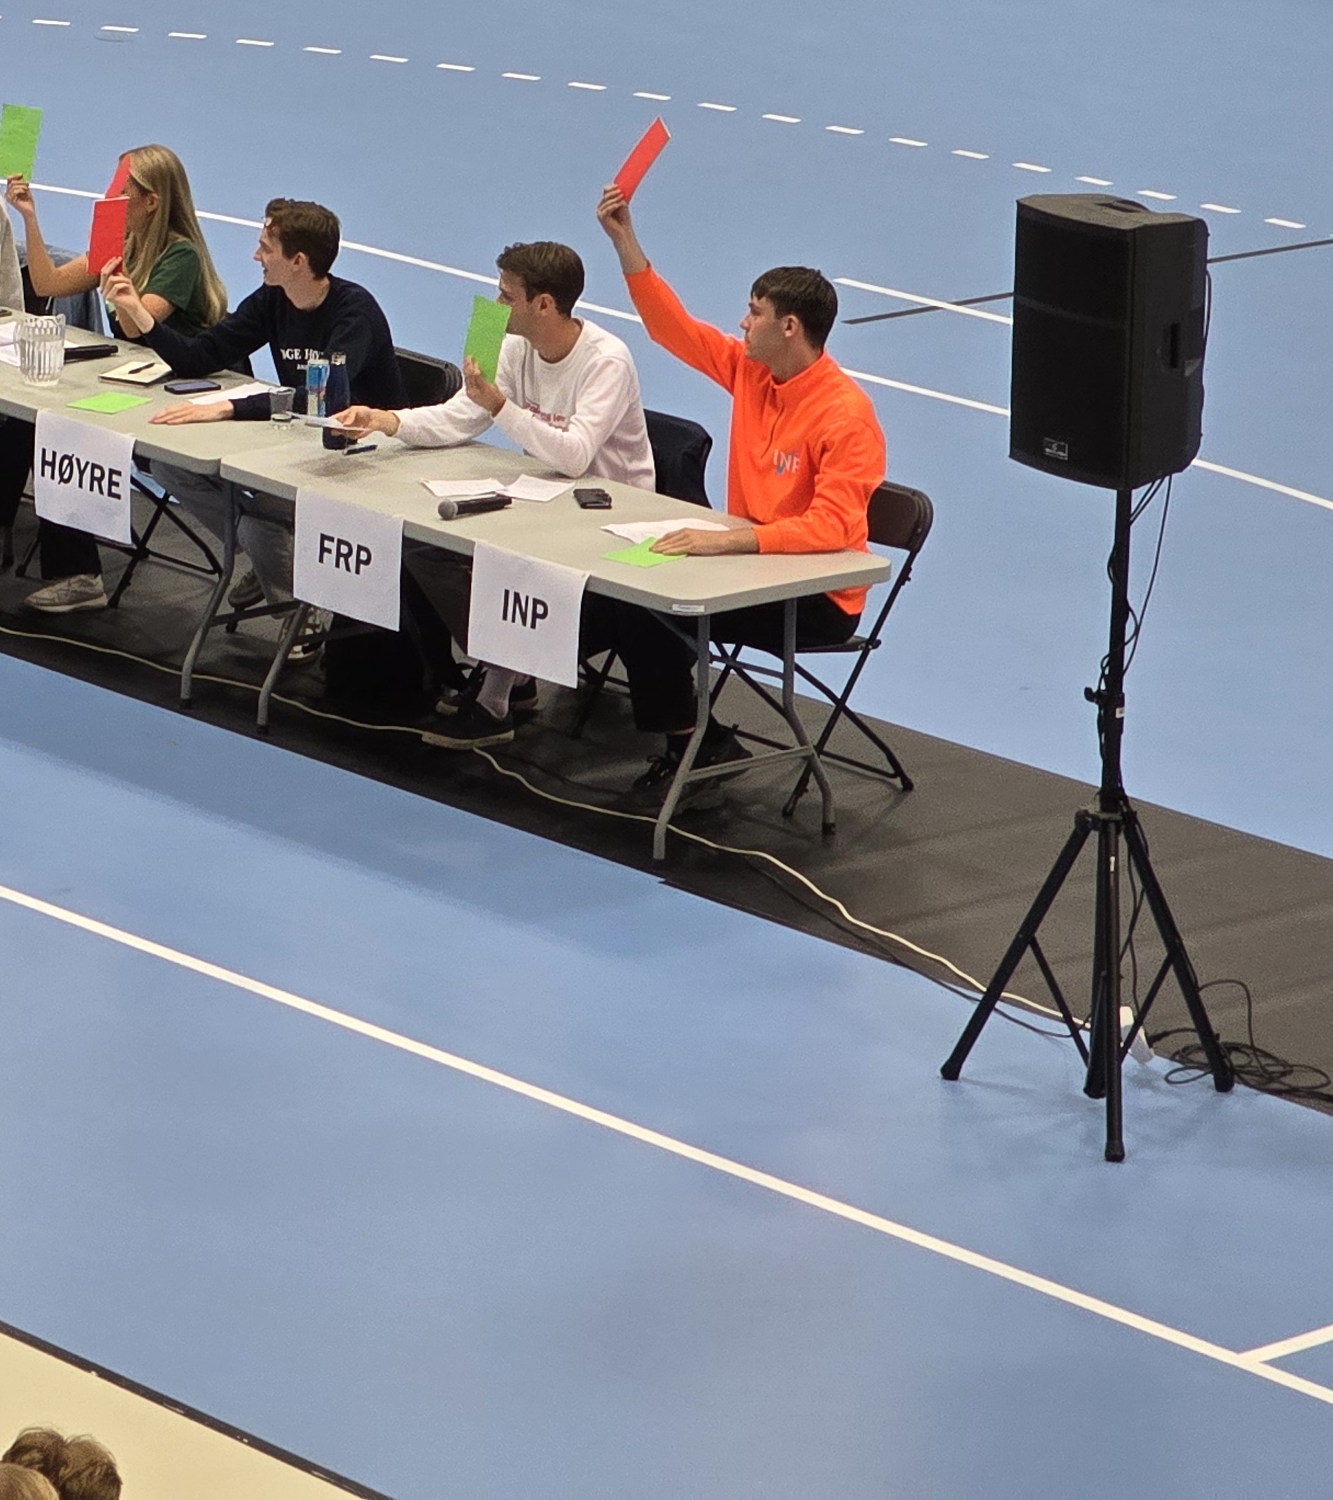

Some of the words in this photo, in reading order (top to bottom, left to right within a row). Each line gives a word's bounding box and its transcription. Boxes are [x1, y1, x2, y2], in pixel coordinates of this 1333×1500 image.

[40, 447, 122, 501] HØYRE
[318, 532, 372, 576] FRP
[502, 588, 549, 630] INP
